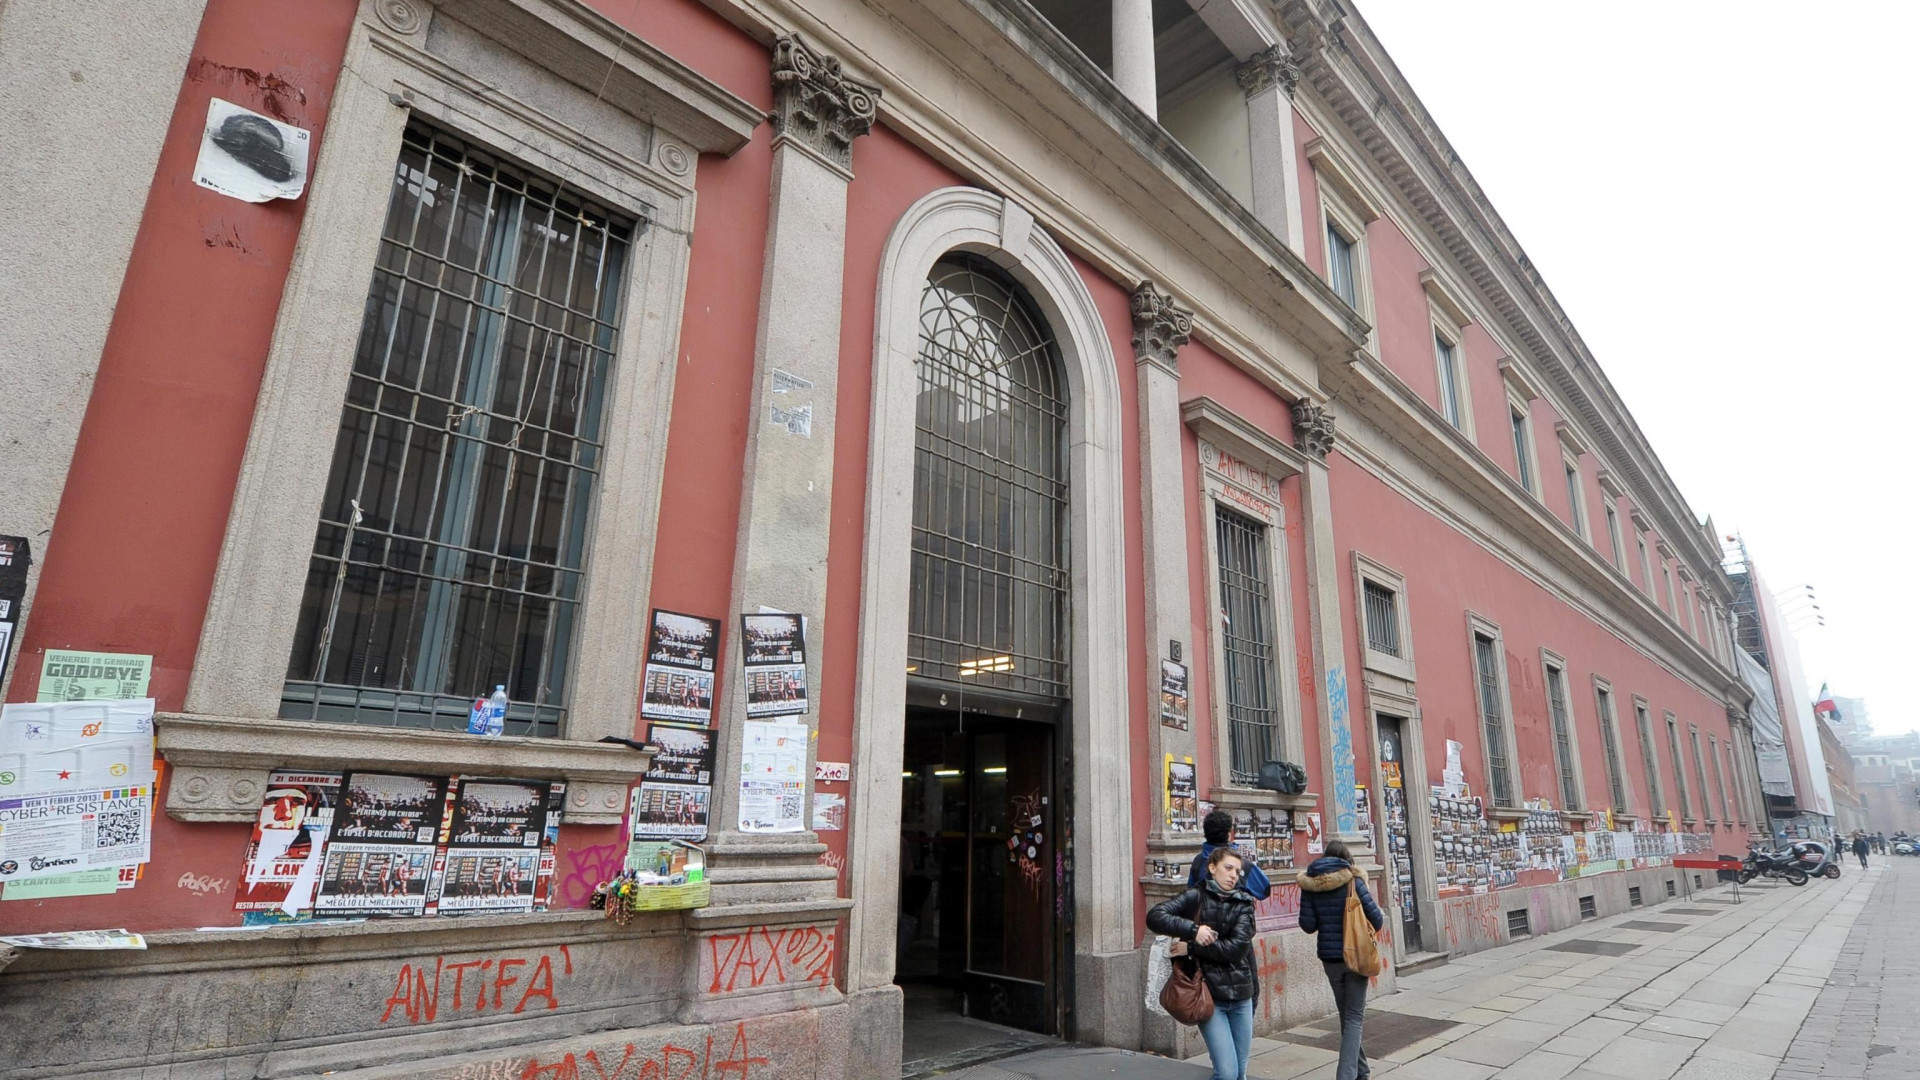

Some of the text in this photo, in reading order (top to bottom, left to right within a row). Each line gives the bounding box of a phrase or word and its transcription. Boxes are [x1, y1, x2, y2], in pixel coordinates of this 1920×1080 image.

[46, 663, 143, 681] GOODBYE
[288, 775, 330, 784] DICEMBRE
[0, 797, 147, 822] CYBER RESISTANCE
[25, 800, 42, 809] VEN
[77, 794, 98, 804] 2013
